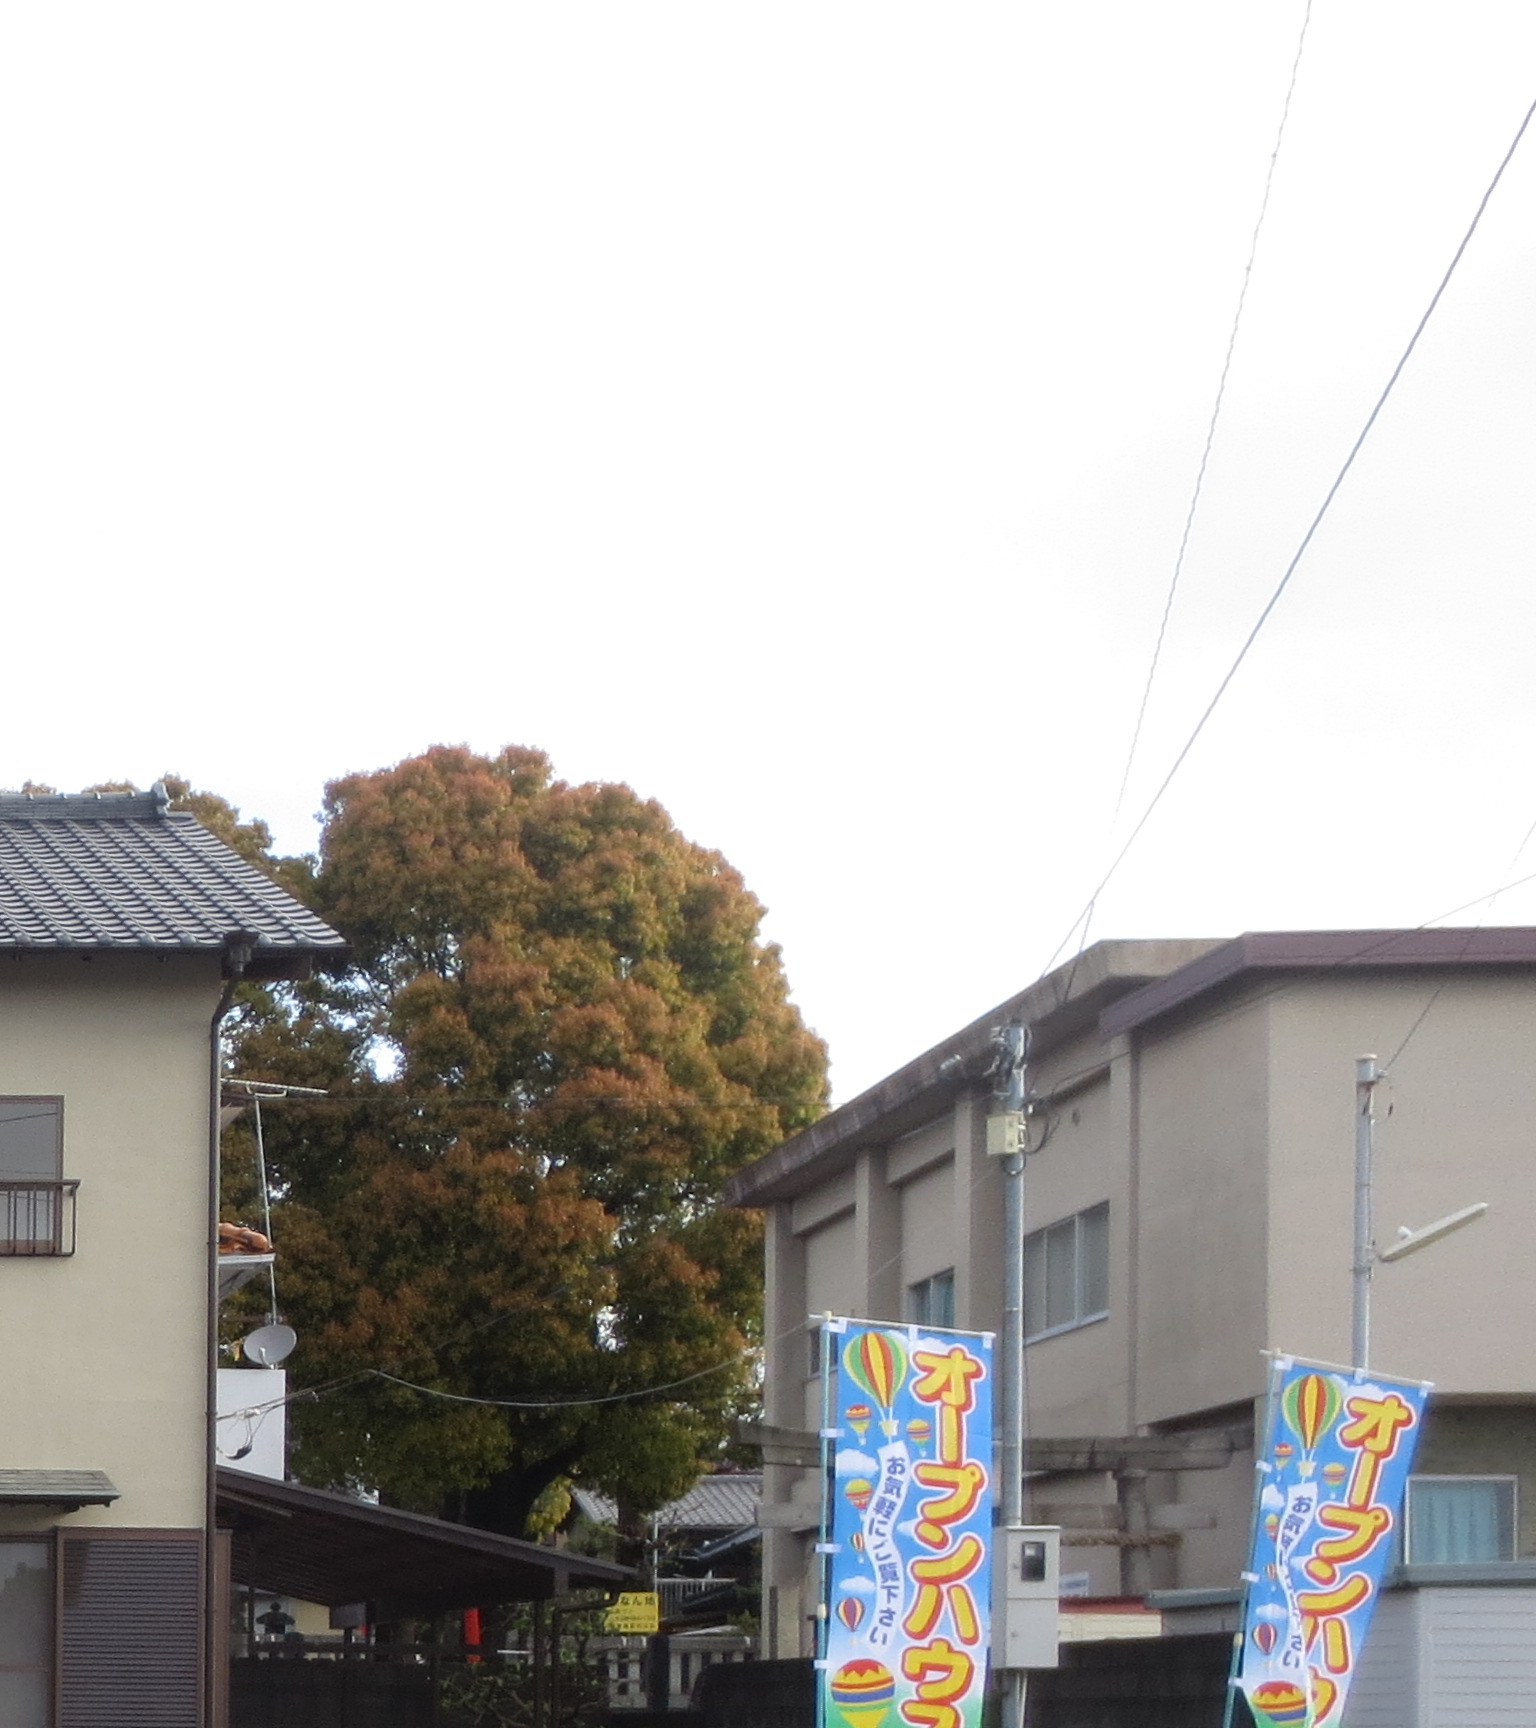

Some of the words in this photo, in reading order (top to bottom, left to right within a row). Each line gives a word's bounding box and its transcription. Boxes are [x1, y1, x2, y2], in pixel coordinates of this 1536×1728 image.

[868, 1455, 907, 1647] お気軽にご覧下さい
